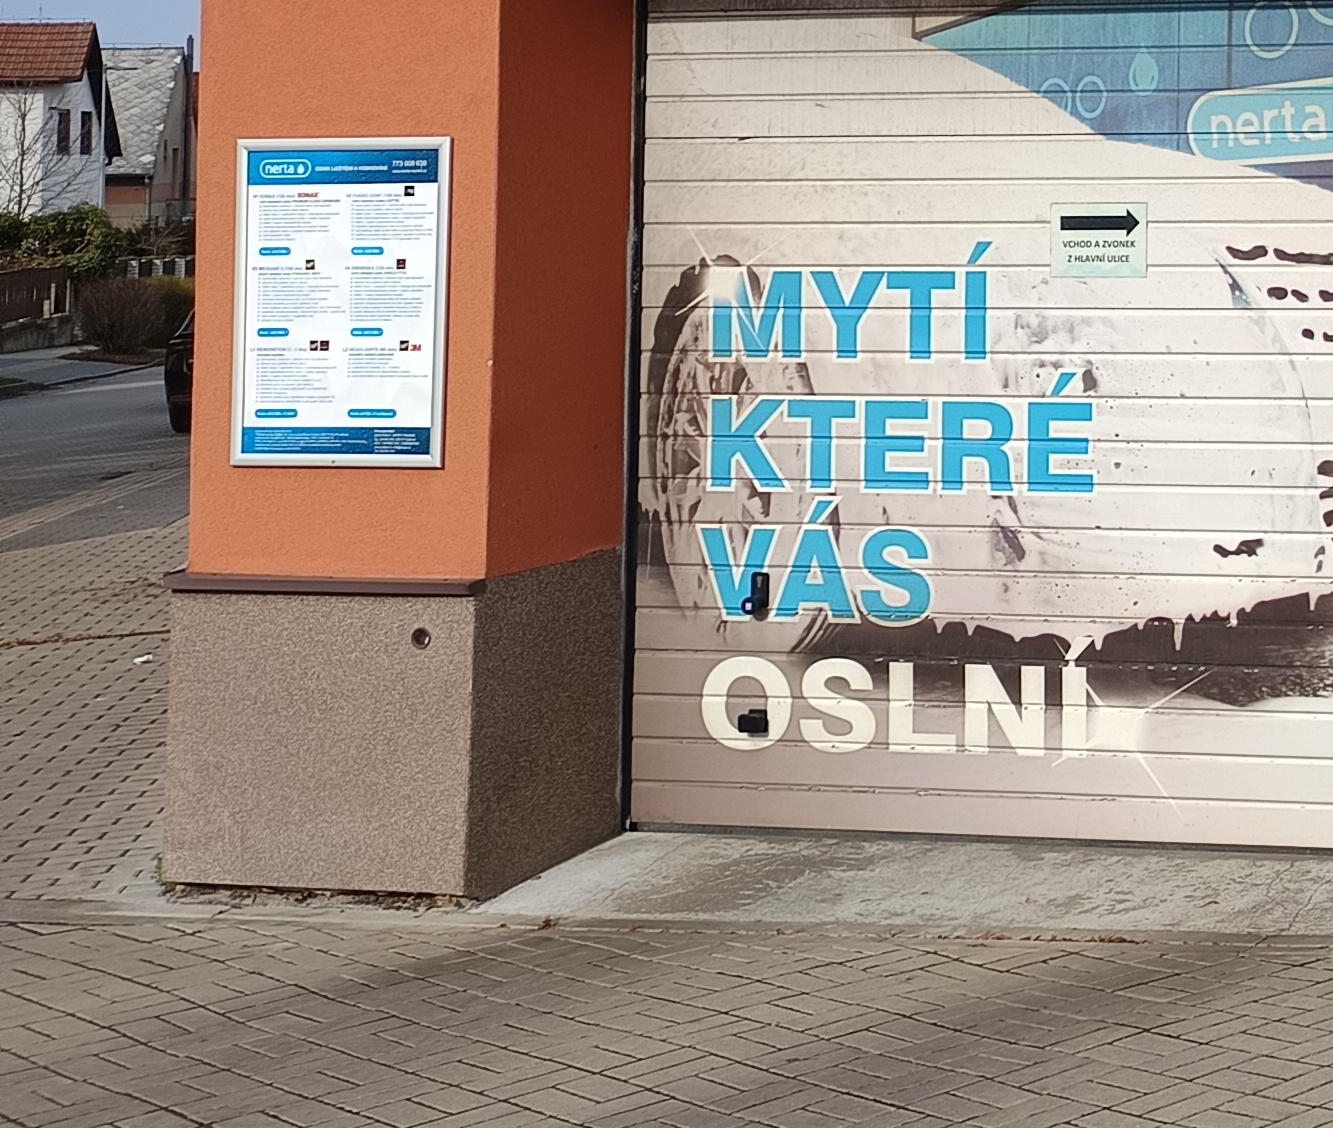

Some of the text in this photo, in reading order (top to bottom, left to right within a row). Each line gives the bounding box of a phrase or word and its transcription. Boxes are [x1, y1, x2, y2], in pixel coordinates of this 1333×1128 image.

[265, 163, 295, 174] nerta
[1209, 99, 1328, 152] nerta
[1062, 240, 1136, 248] VCHOD A ZVONEK
[1067, 253, 1131, 263] Z HLAVNÍ ULICE
[708, 240, 995, 363] MYTÍ
[705, 370, 1097, 496] KTERÉ
[696, 496, 934, 627] VÁS
[701, 636, 1095, 757] OSLNÍ
